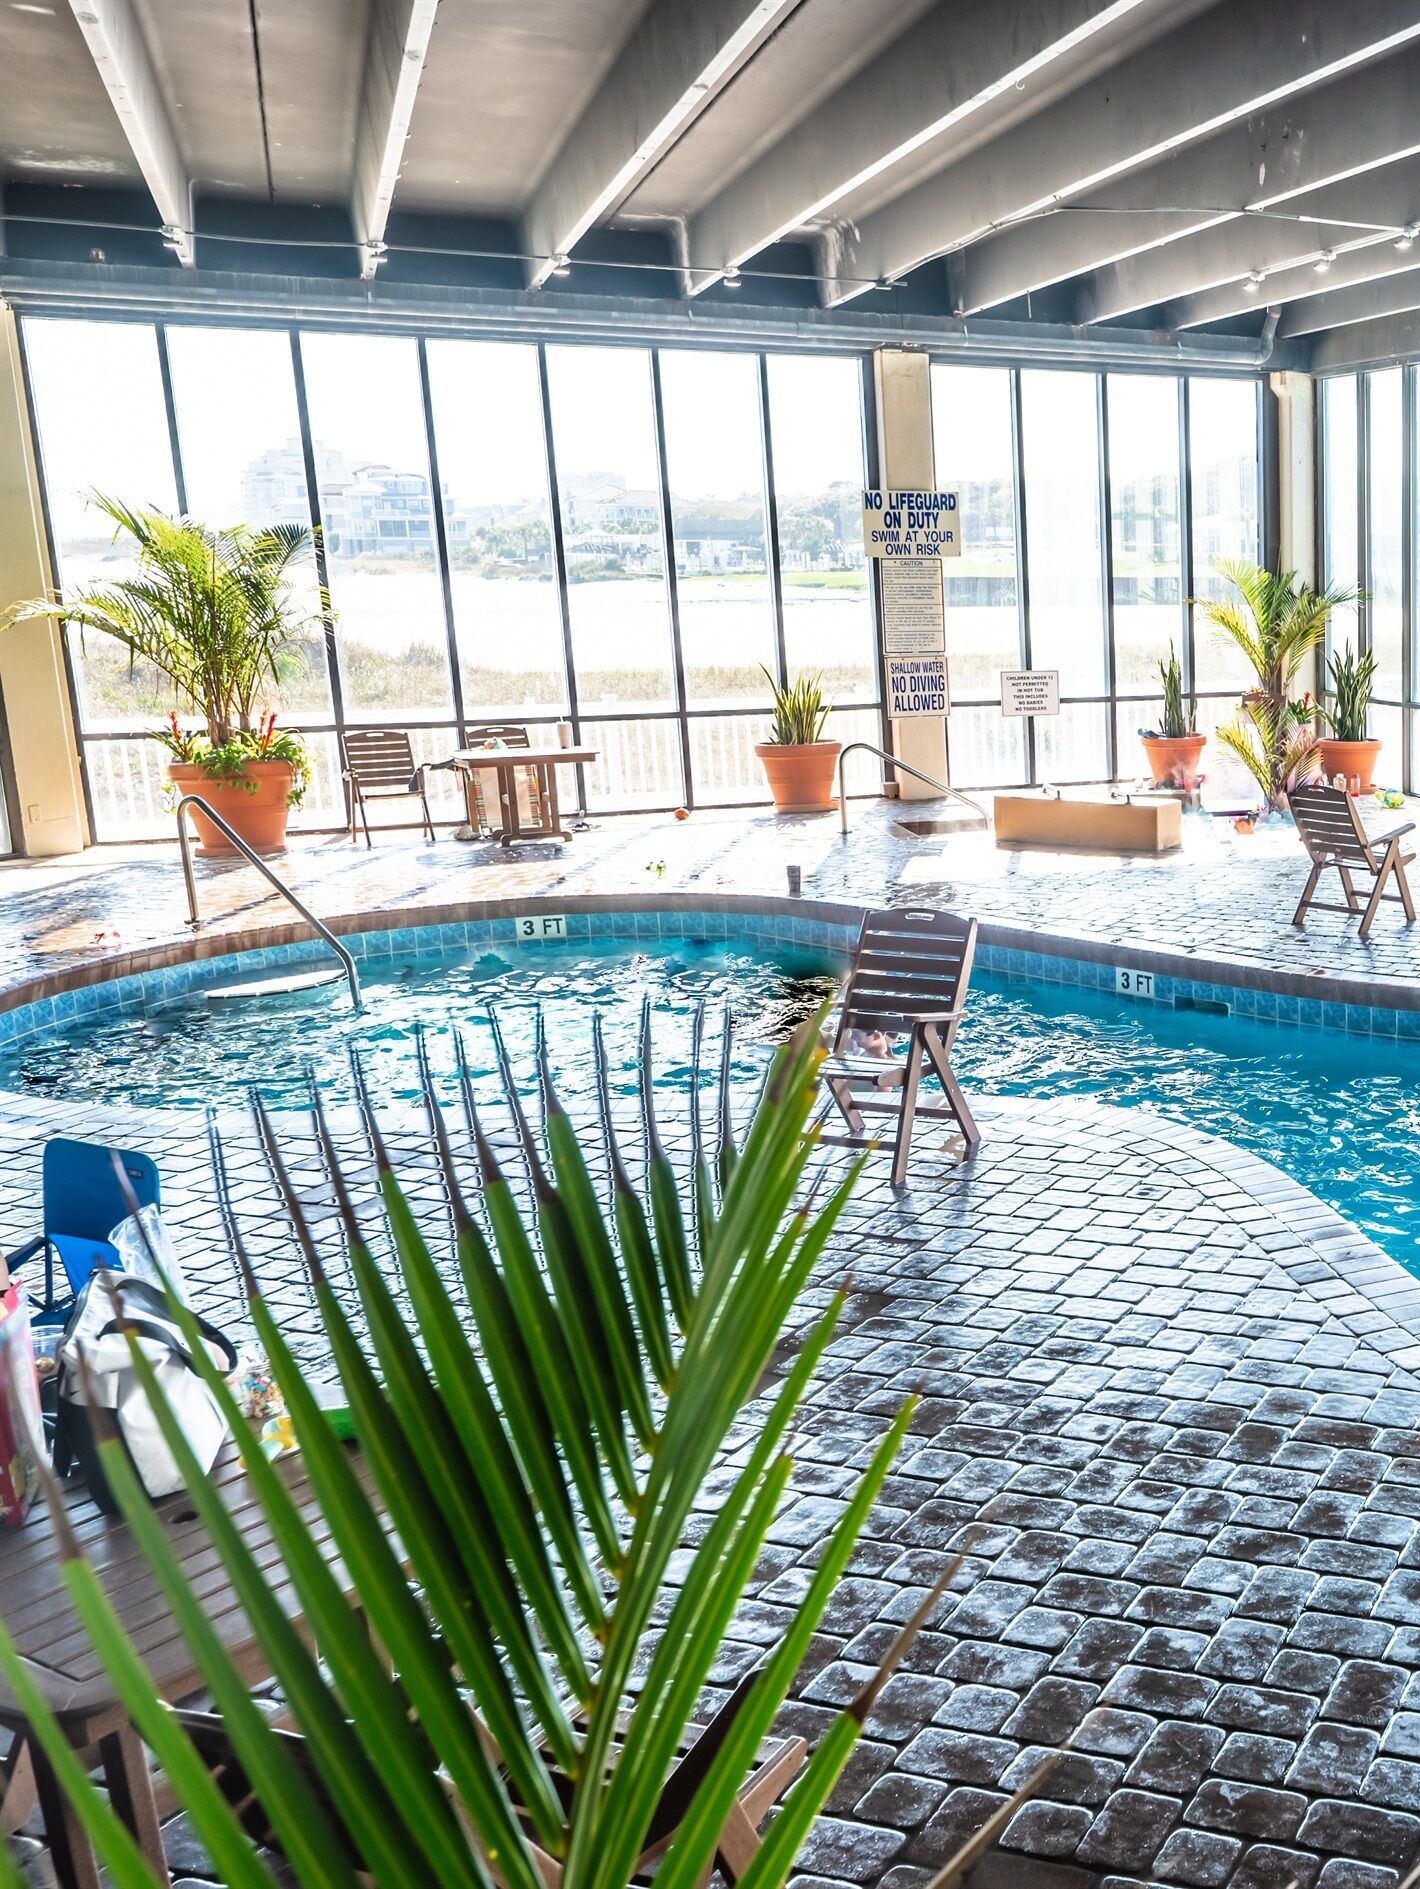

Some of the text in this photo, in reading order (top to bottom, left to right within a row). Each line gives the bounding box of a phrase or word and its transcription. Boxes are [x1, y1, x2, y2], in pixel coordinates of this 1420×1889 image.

[865, 492, 956, 510] NO LIFEGUARD
[884, 511, 939, 528] ON DUTY
[872, 530, 953, 542] SWIM AT YOUR
[886, 544, 941, 555] OWN RISK
[891, 662, 944, 674] SHALLOW WATER
[892, 675, 945, 693] NO DIVING
[895, 694, 944, 711] ALLOWED
[523, 918, 562, 936] 3 FT
[1121, 972, 1152, 993] 3 FT
